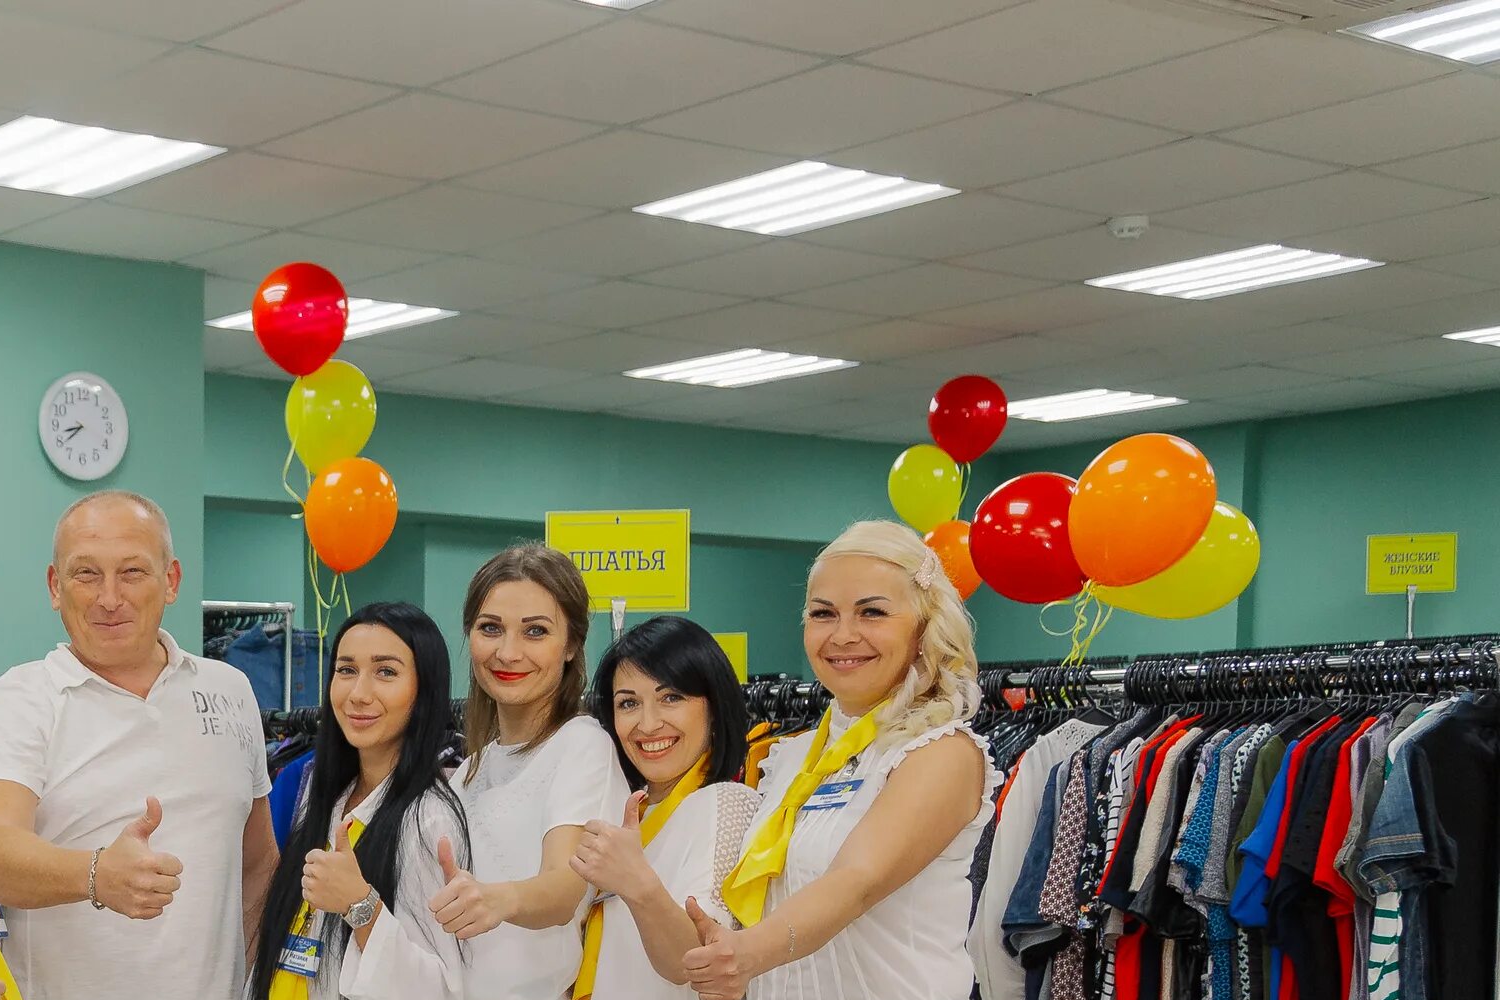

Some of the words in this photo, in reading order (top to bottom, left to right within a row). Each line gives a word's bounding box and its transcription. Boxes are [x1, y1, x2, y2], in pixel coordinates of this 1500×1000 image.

[64, 392, 75, 405] 11
[76, 388, 90, 401] 12
[94, 394, 99, 407] 1
[53, 404, 67, 417] 10
[101, 407, 109, 420] 2
[51, 419, 60, 432] 9
[105, 422, 113, 435] 3
[101, 438, 109, 450] 4
[65, 447, 73, 460] 7
[78, 453, 87, 466] 6
[92, 449, 100, 462] 5
[569, 549, 666, 572] ПЛАТЬЯ
[1384, 552, 1440, 563] ЖЕНСКИЕ
[201, 717, 254, 745] JEANS
